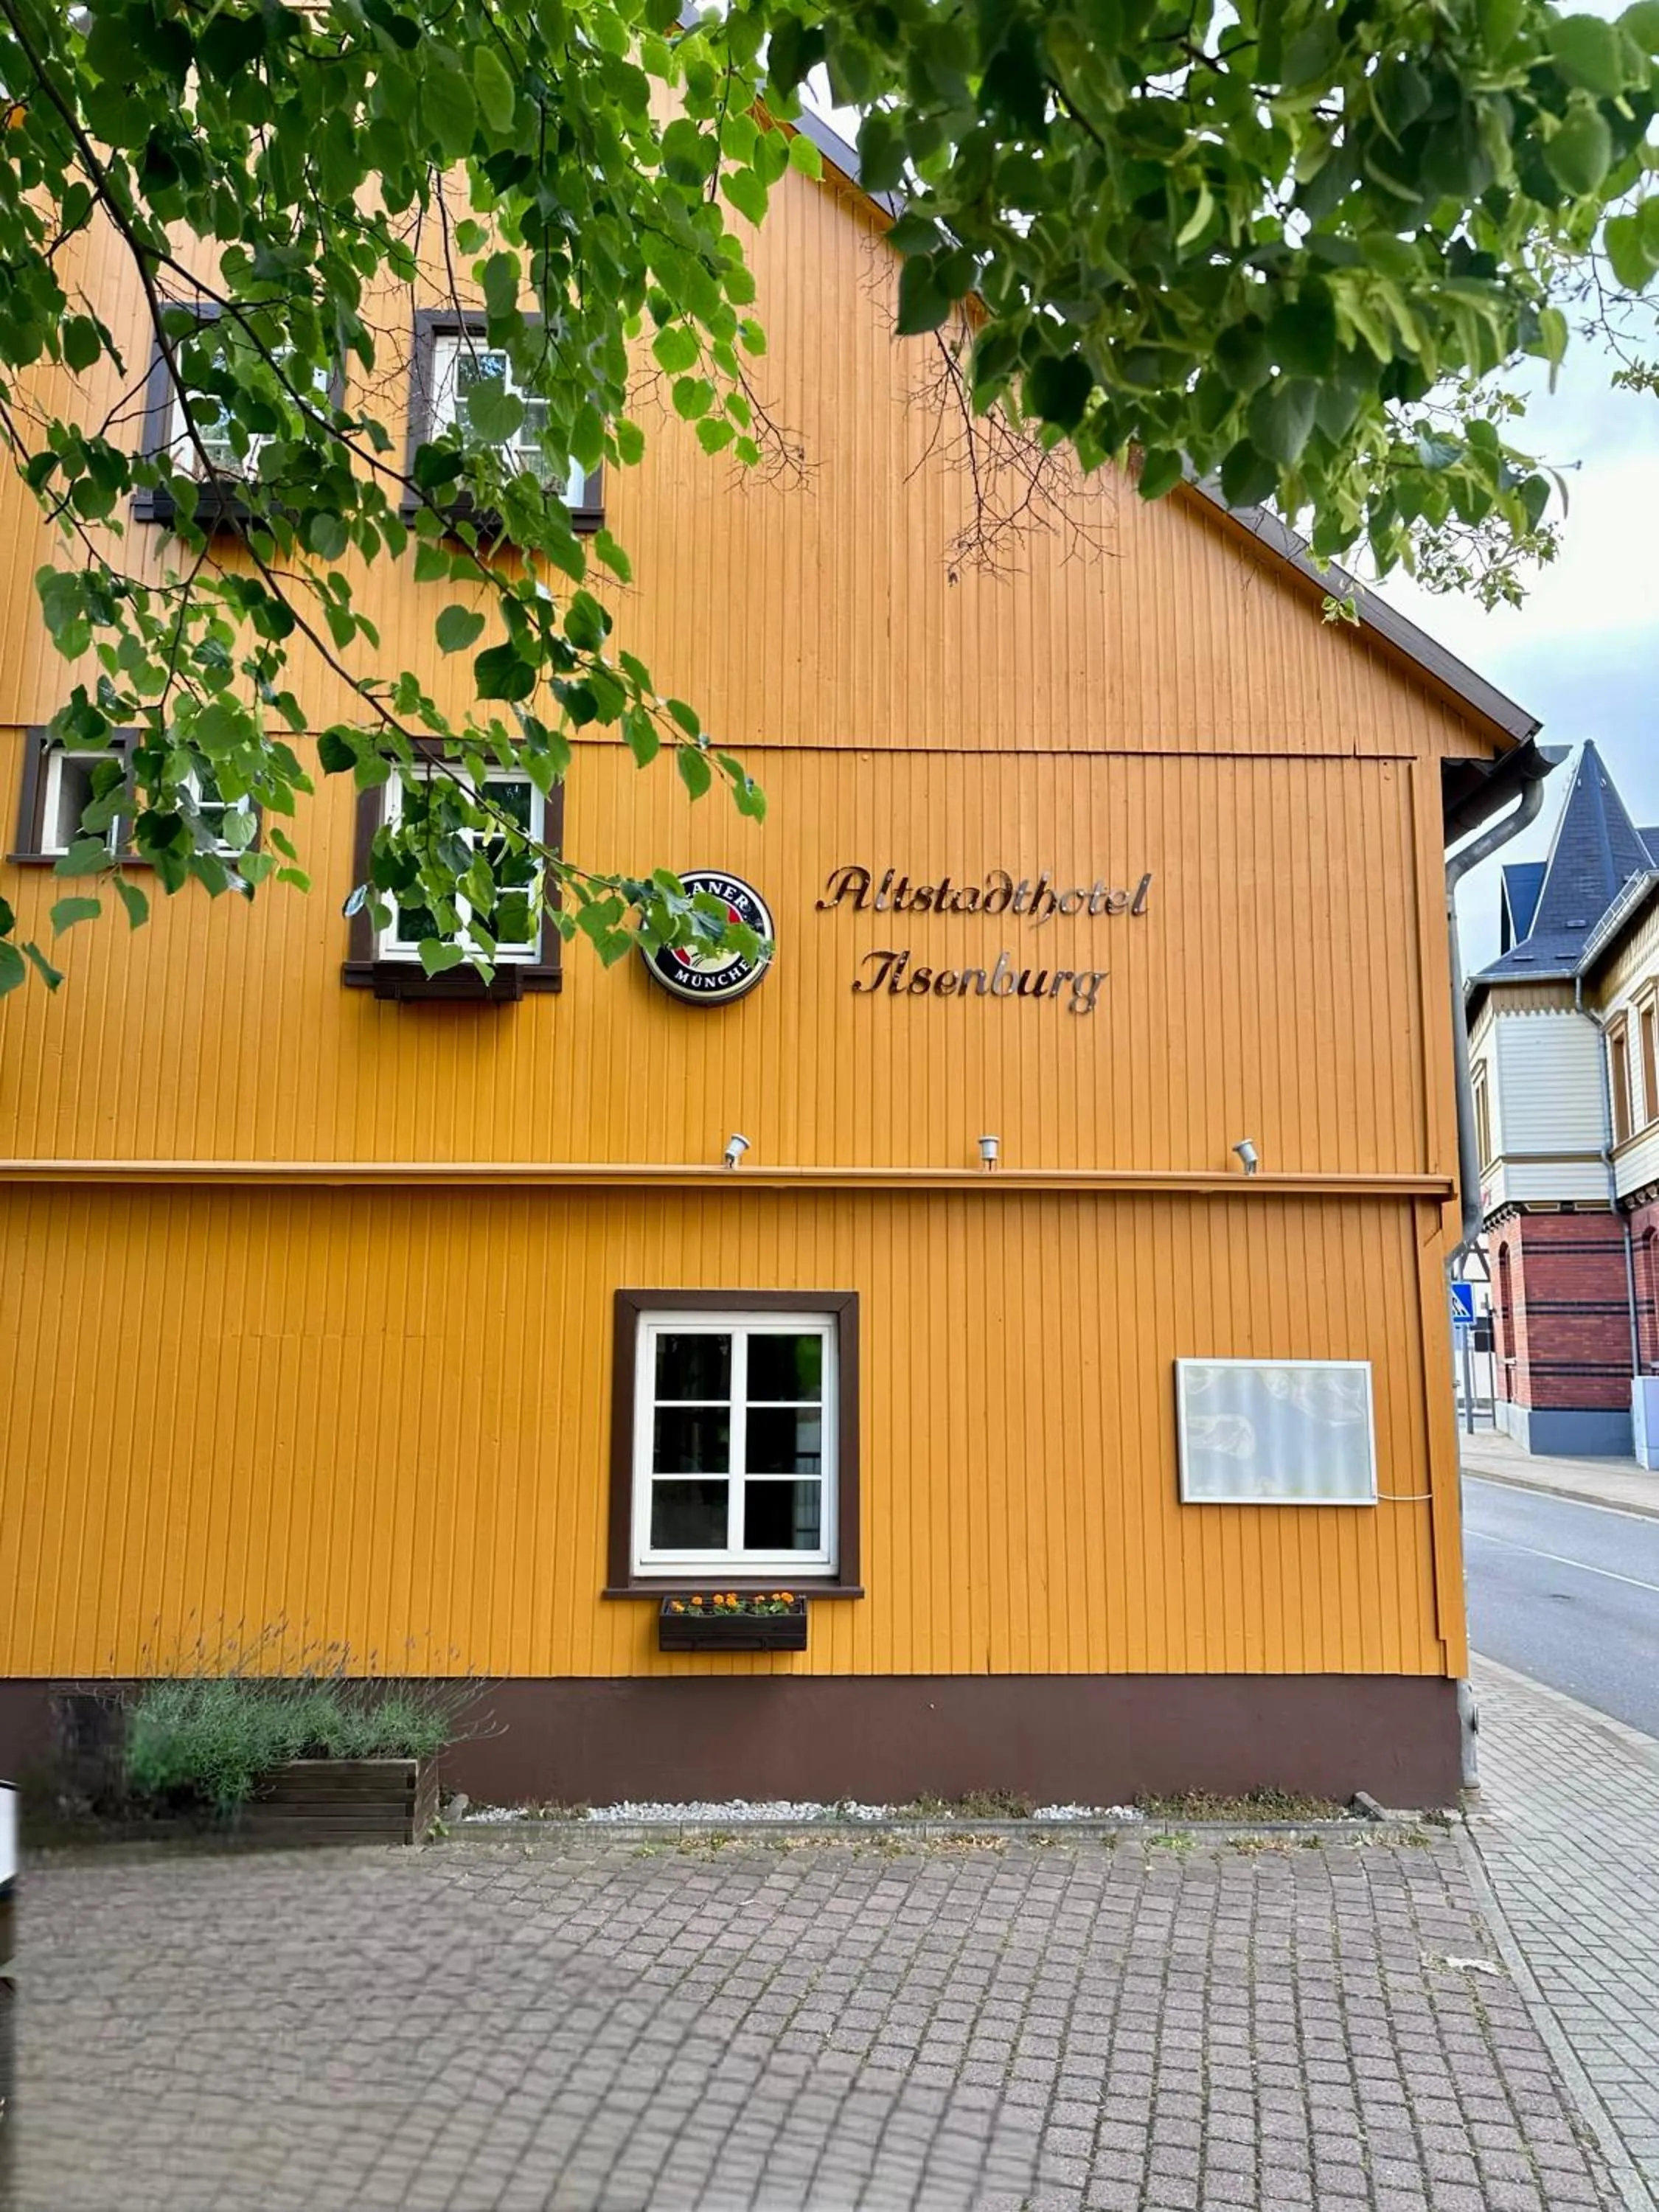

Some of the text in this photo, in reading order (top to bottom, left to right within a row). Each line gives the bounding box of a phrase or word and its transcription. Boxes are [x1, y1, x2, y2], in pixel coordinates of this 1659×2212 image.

[684, 881, 750, 912] ANER
[815, 865, 1152, 929] Altstadthotel
[674, 959, 751, 988] MÜNCHE
[852, 950, 1109, 1016] Ilsenburg
